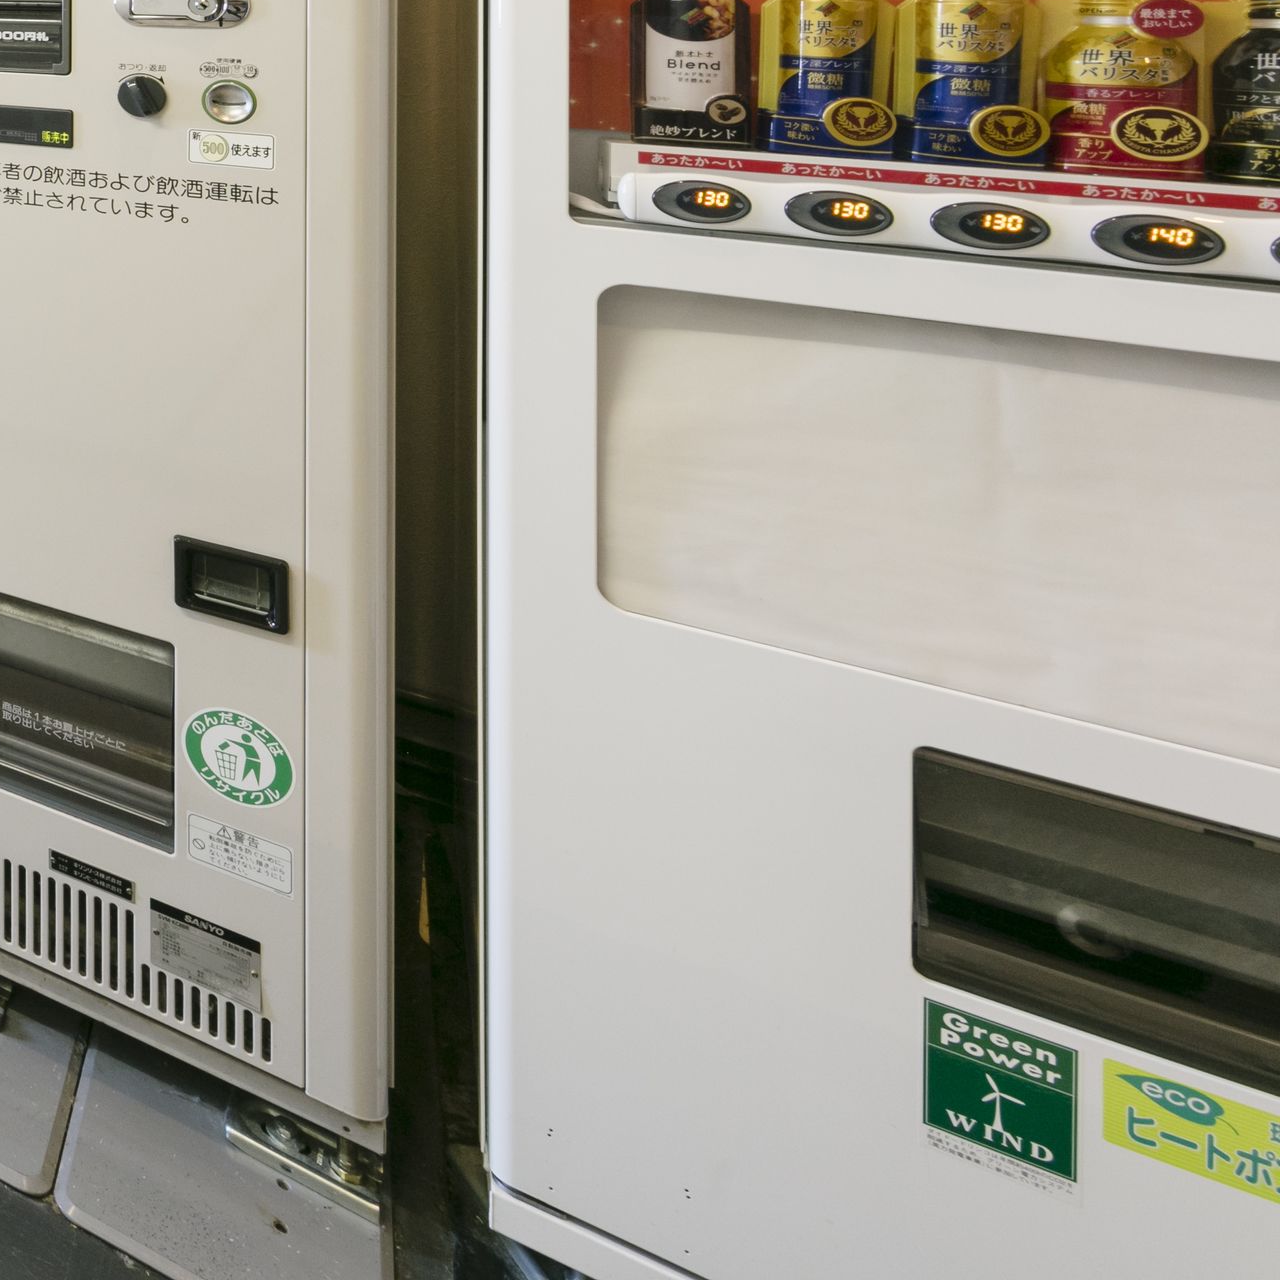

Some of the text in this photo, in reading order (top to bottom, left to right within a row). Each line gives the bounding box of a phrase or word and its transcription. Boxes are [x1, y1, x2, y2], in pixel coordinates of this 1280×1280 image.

[1139, 8, 1192, 20] 最後まで
[1142, 19, 1193, 29] おいしい
[937, 40, 996, 52] バリスタ
[667, 58, 721, 71] Blend
[1081, 48, 1161, 67] 世界一
[118, 63, 167, 72] おつり・返却
[1080, 67, 1159, 82] バリスタ
[807, 72, 844, 86] 微糖
[950, 77, 991, 91] 微糖
[1086, 88, 1167, 100] 香るブレンド
[41, 130, 70, 144] 販売中
[192, 132, 201, 141] 新
[649, 124, 738, 140] 絶妙ブレンド
[202, 141, 225, 156] 500
[1078, 138, 1105, 148] 香り
[231, 143, 272, 159] 使えます
[1075, 148, 1114, 160] アップ
[2, 710, 95, 750] 取り出してください
[192, 712, 284, 757] のんだあとは
[200, 766, 280, 805] リサイクル
[184, 914, 225, 936] SANYO
[942, 1012, 1057, 1066] Green
[940, 1028, 1062, 1084] Power
[1141, 1081, 1211, 1114] eco
[945, 1108, 1054, 1162] WIND
[1127, 1106, 1280, 1194] ヒートポ
